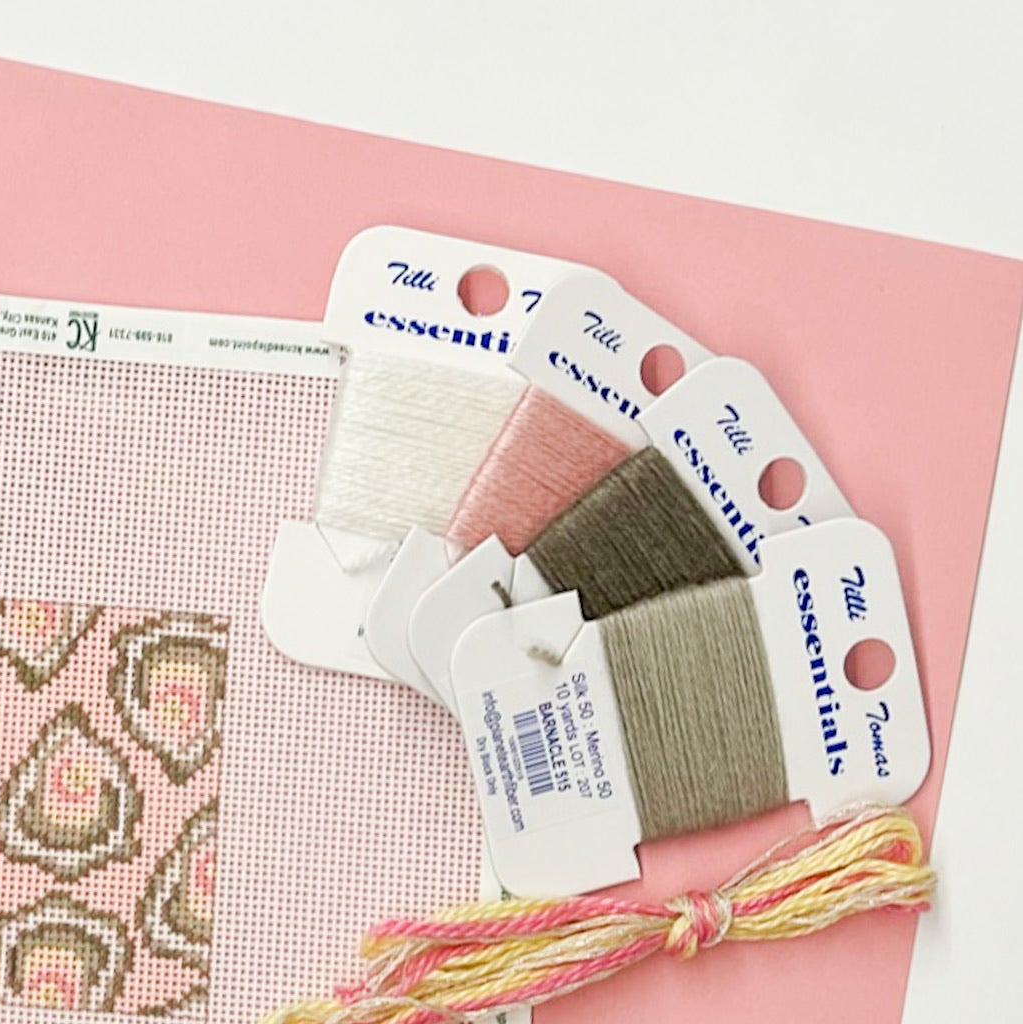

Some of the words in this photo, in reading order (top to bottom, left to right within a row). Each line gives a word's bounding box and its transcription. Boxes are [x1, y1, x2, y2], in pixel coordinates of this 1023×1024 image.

[387, 262, 436, 291] Tilli
[1, 310, 22, 324] City,
[24, 314, 58, 328] Kansas
[19, 328, 39, 340] East
[41, 330, 57, 341] 410
[66, 318, 98, 352] KC
[109, 328, 173, 344] 816-599-7331
[364, 308, 510, 354] essenti
[583, 310, 621, 354] Tilli
[209, 338, 330, 356] www.kcneedlepoint.com
[716, 404, 753, 456] Tilli
[793, 568, 850, 776] essentials
[840, 566, 867, 621] Tilli
[866, 701, 890, 777] Tomas
[555, 682, 571, 700] 10
[571, 672, 588, 700] Silk
[556, 702, 579, 742] yards
[578, 701, 594, 720] 50
[538, 701, 566, 770] BARNACLE
[554, 770, 571, 792] 515
[568, 743, 586, 768] LOT
[585, 730, 605, 779] Merino
[576, 777, 593, 798] 207
[596, 780, 613, 799] 50
